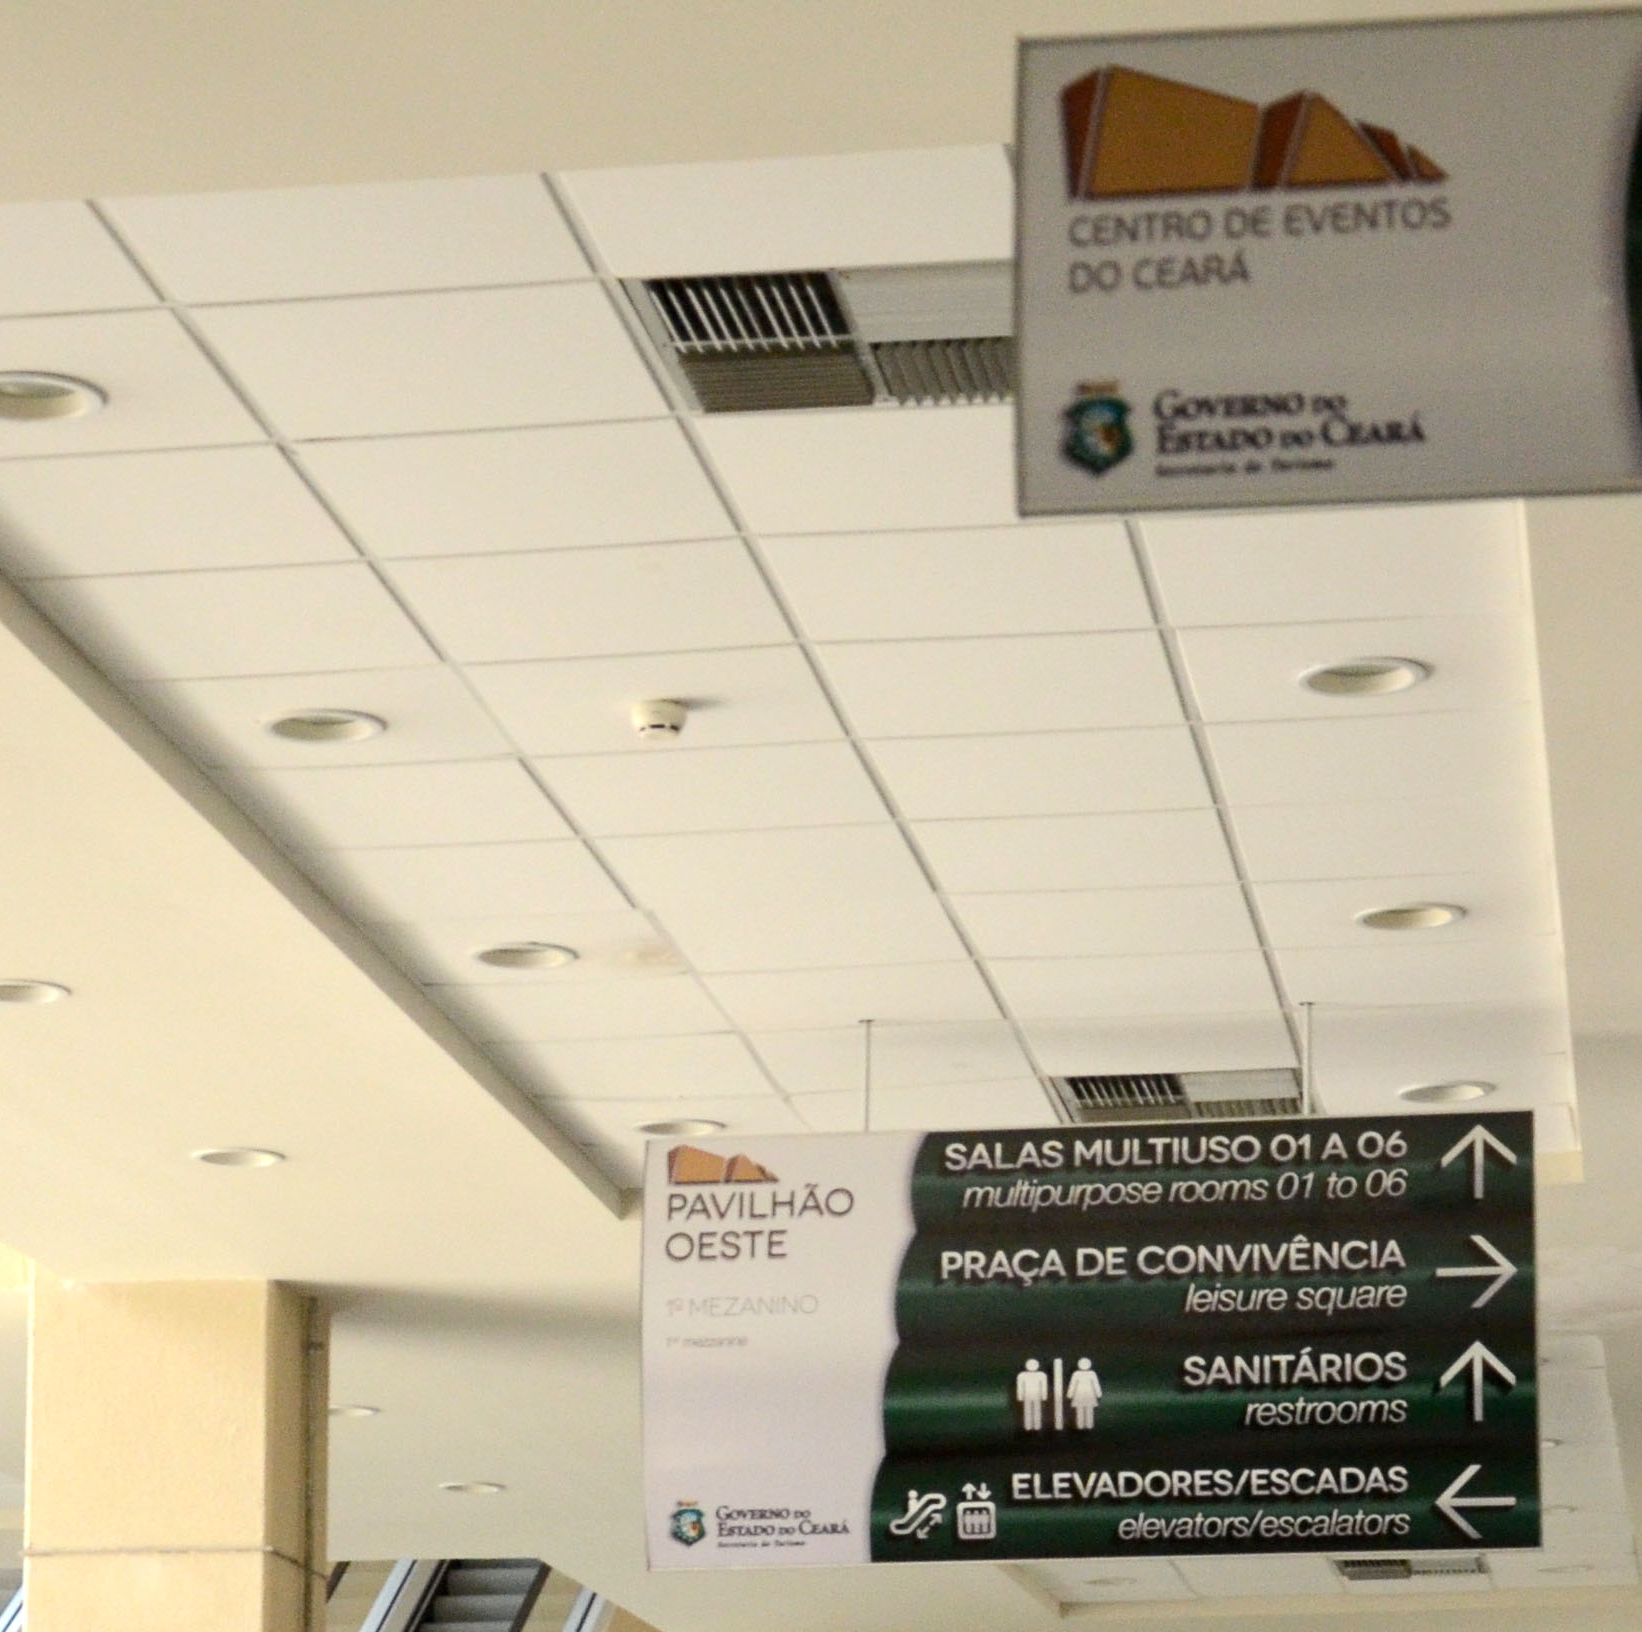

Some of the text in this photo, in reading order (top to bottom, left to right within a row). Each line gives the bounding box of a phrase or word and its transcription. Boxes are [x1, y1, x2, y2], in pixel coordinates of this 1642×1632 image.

[1068, 198, 1452, 247] CENTRO DE EVENTOS
[1068, 249, 1252, 293] DO CEARÁ
[944, 1130, 1408, 1171] SALAS MULTIUSO 01 A 06
[667, 1183, 855, 1222] PAVILHÃO
[962, 1168, 1408, 1213] multipurpose rooms 01 to 06
[665, 1229, 789, 1262] OESTE
[941, 1234, 1406, 1287] PRAÇA DE CONVIVÊNCIA
[688, 1294, 820, 1317] MEZANINO
[1185, 1283, 1408, 1316] leisure square
[1183, 1347, 1408, 1386] SANITÁRIOS
[1244, 1397, 1408, 1427] restrooms
[1012, 1466, 1409, 1500] ELEVADORES/ESCADAS
[715, 1505, 791, 1522] GOVERNO
[717, 1521, 775, 1538] ESTADO
[798, 1518, 850, 1536] CEARÁ
[1118, 1509, 1411, 1541] elevators/escalators
